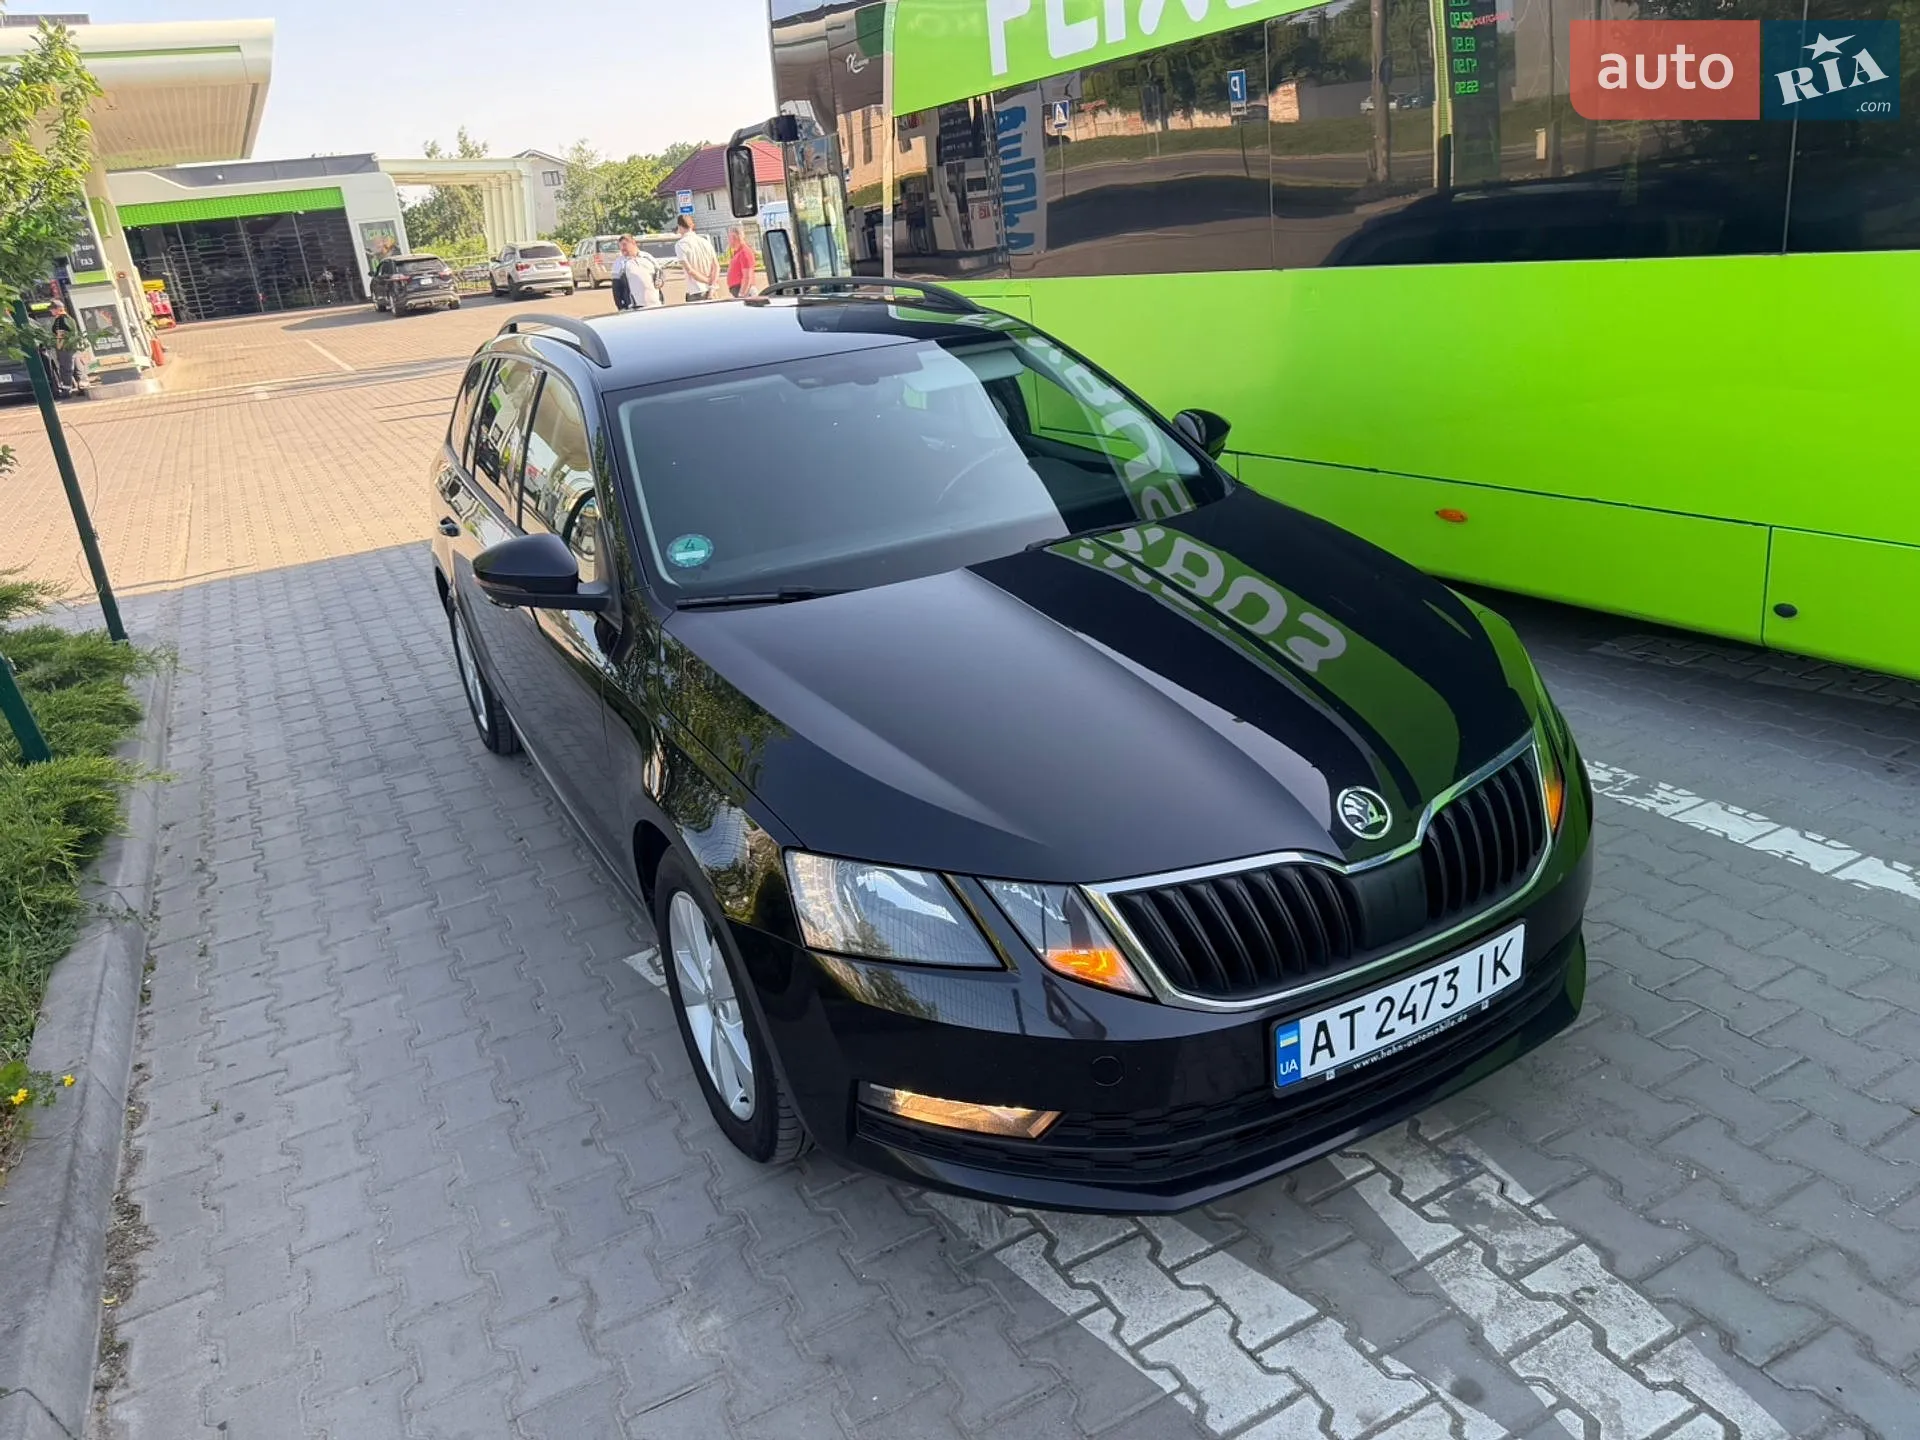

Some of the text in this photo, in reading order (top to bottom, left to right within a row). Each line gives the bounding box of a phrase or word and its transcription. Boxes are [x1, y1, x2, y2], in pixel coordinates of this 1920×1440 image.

[1310, 937, 1516, 1066] AT 2473 IK
[1280, 1060, 1299, 1076] UA
